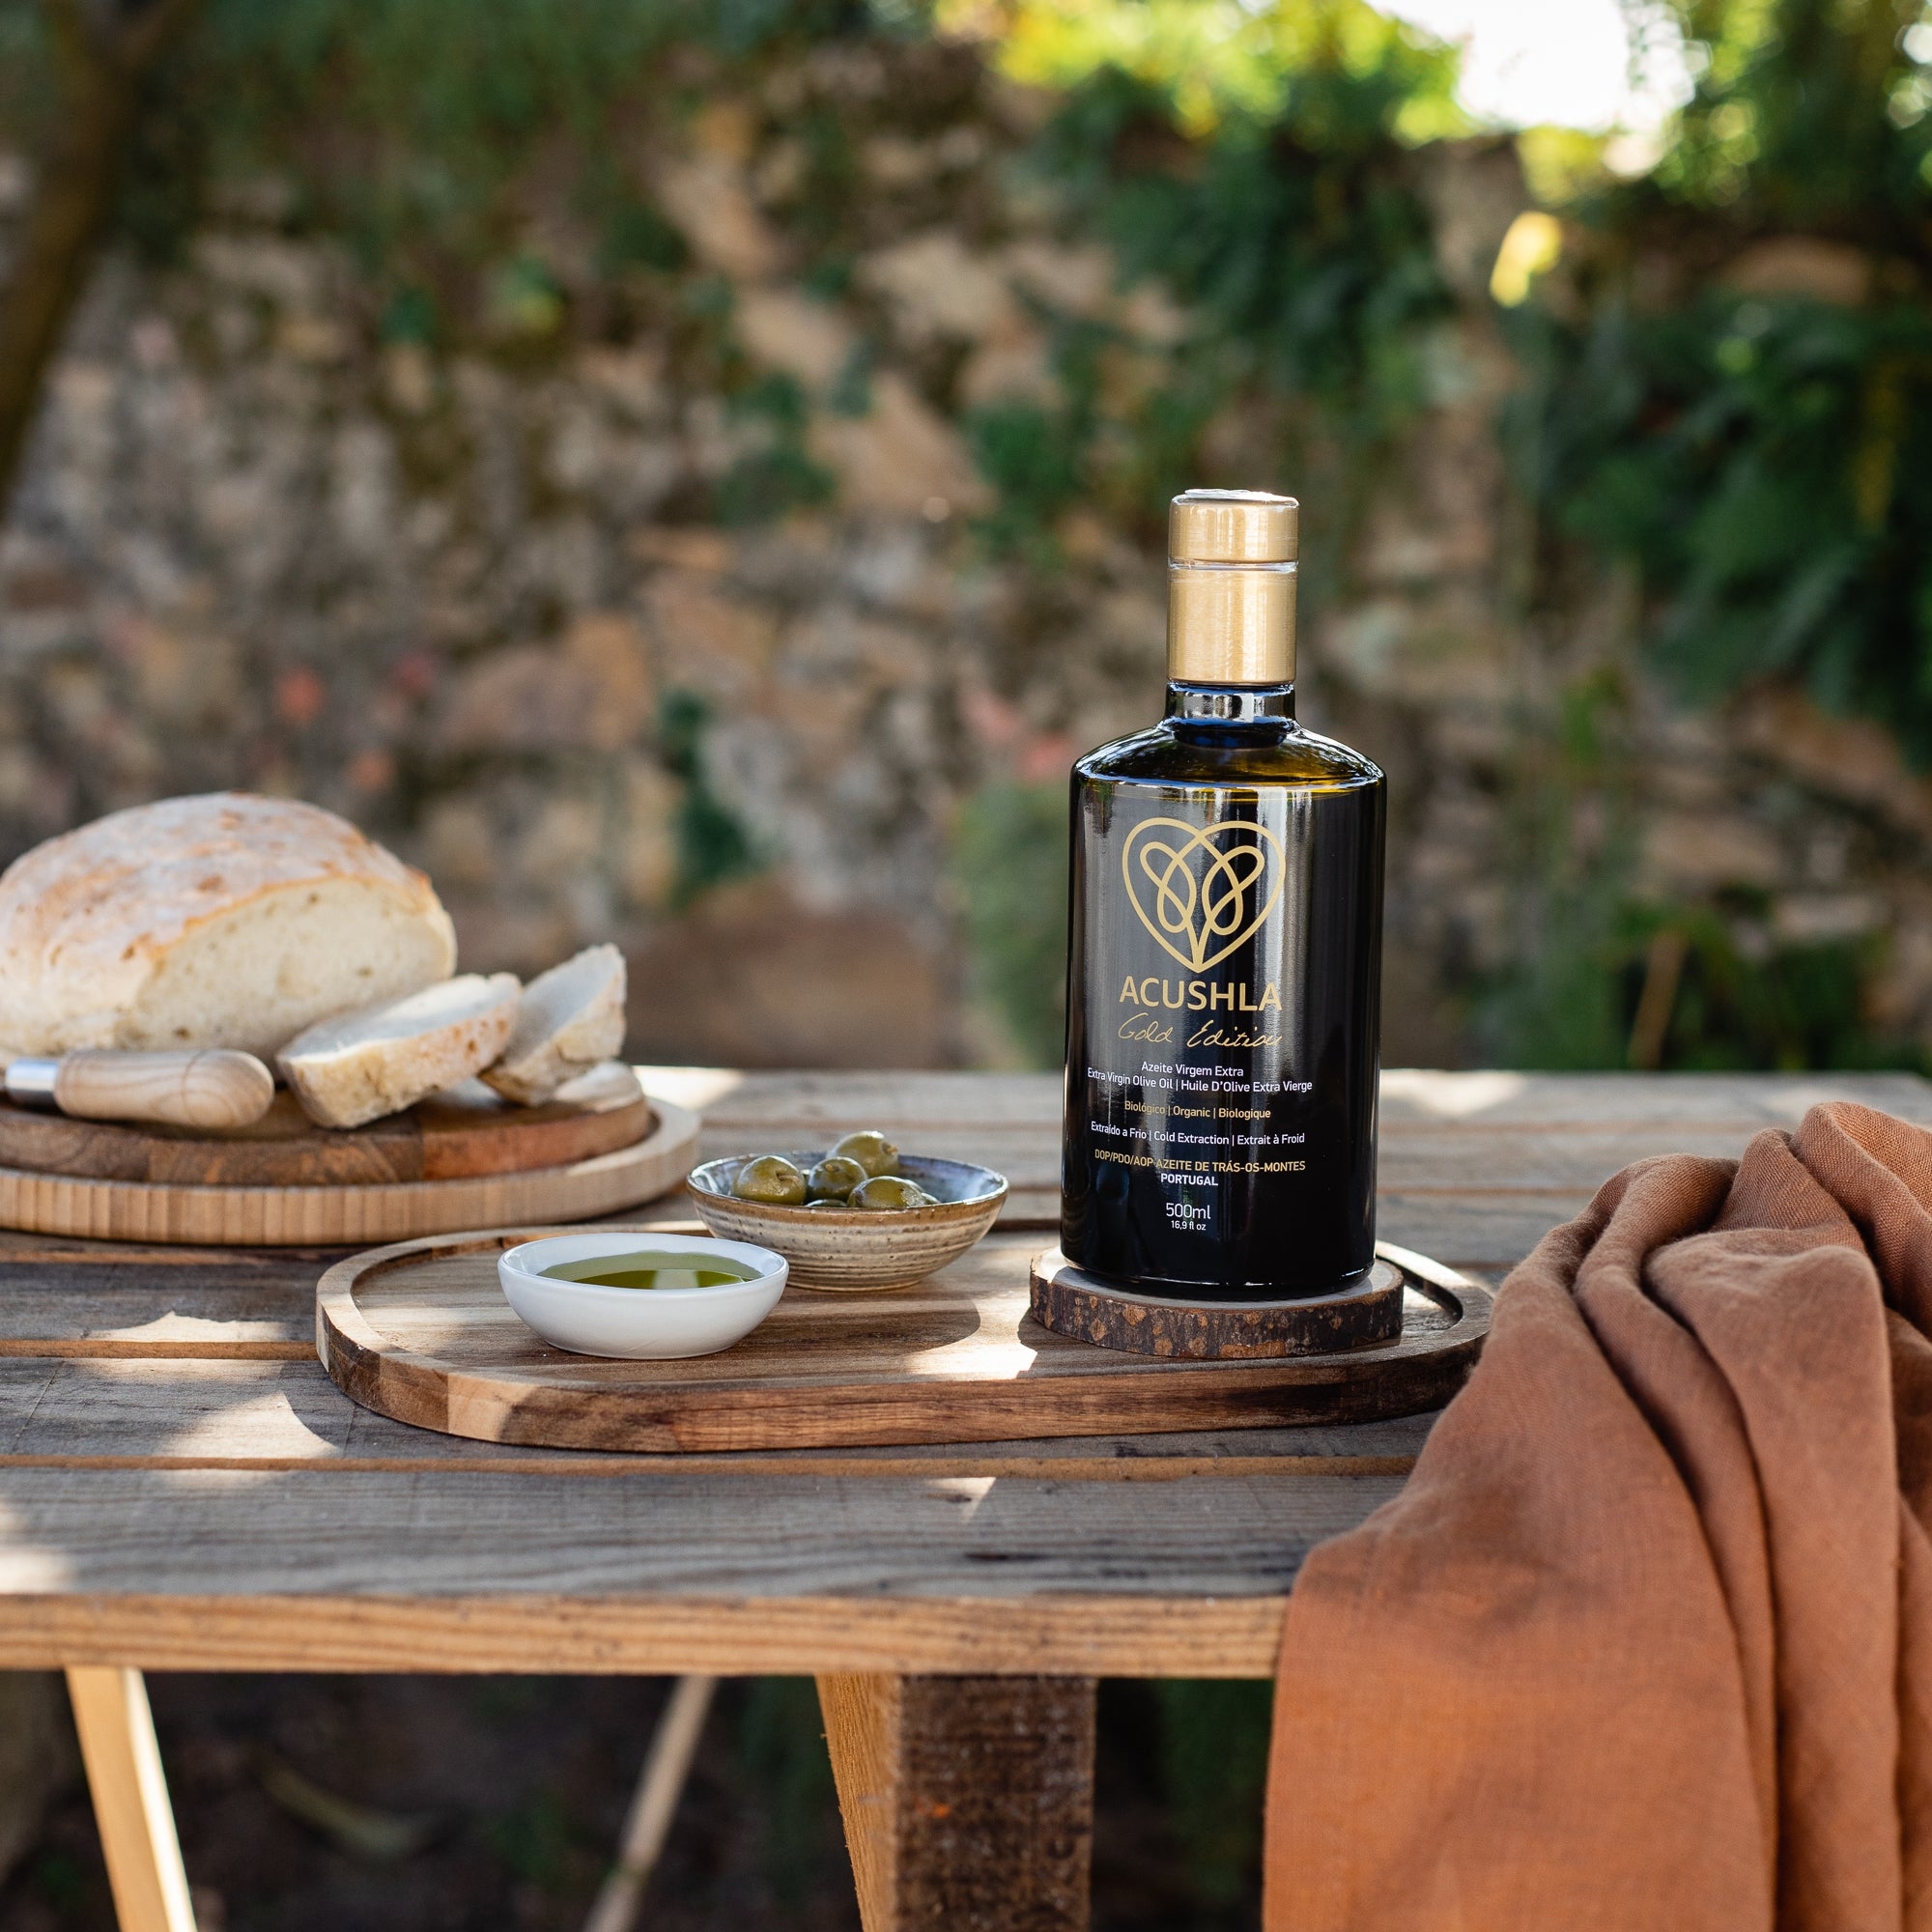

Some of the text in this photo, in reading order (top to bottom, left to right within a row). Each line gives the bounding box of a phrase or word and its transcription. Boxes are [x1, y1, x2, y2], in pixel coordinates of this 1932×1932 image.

[1119, 975, 1283, 1011] ACUSHLA
[1118, 1012, 1283, 1048] Gold Edition
[1087, 1066, 1106, 1081] Extra
[1106, 1071, 1131, 1087] Virgin
[1132, 1075, 1157, 1088] Olive
[1158, 1078, 1174, 1090] Oil
[1180, 1079, 1209, 1092] Huile
[1253, 1081, 1281, 1093] Extra
[1282, 1080, 1313, 1094] Vierge
[1141, 1061, 1244, 1078] Azeite Virgem Extra
[1124, 1100, 1271, 1121] Biológico Organic Biologique
[1091, 1121, 1305, 1146] Extraído a Frio Cold Extraction Extrait à Froid
[1094, 1149, 1306, 1173] DOP/PDO/AOP AZEITE DE TRÁS-OS-MONTES
[1160, 1173, 1219, 1186] PORTUGAL
[1165, 1202, 1211, 1220] 500ml
[1170, 1219, 1187, 1231] 16,9
[1188, 1220, 1195, 1231] fl
